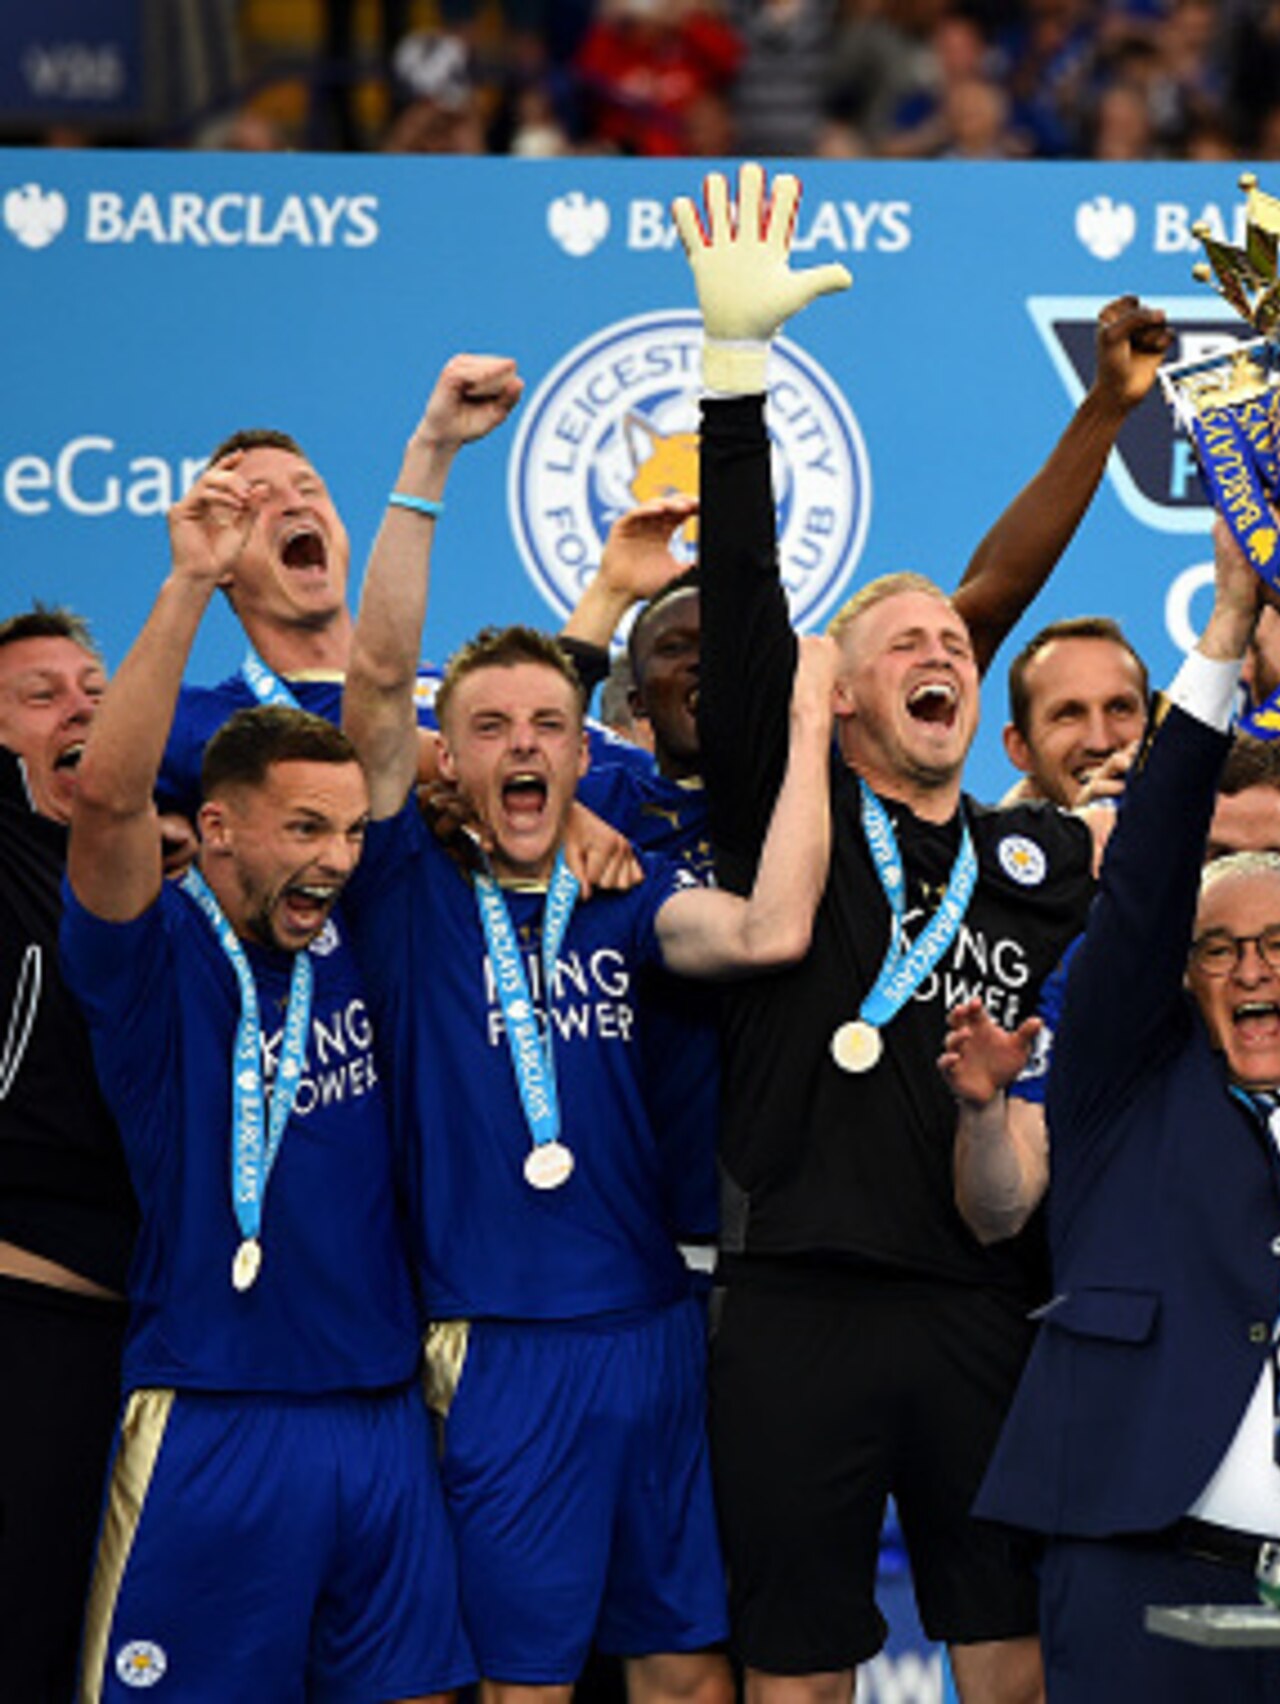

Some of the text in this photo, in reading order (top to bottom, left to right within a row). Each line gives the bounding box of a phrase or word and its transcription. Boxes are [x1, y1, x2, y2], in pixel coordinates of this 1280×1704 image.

[86, 191, 379, 246] BARCLAYS
[1202, 409, 1262, 533] BARCLAYS
[259, 1000, 374, 1078] KNG
[514, 1021, 550, 1123] BARCLAYS
[236, 1097, 264, 1203] BARCLAYS
